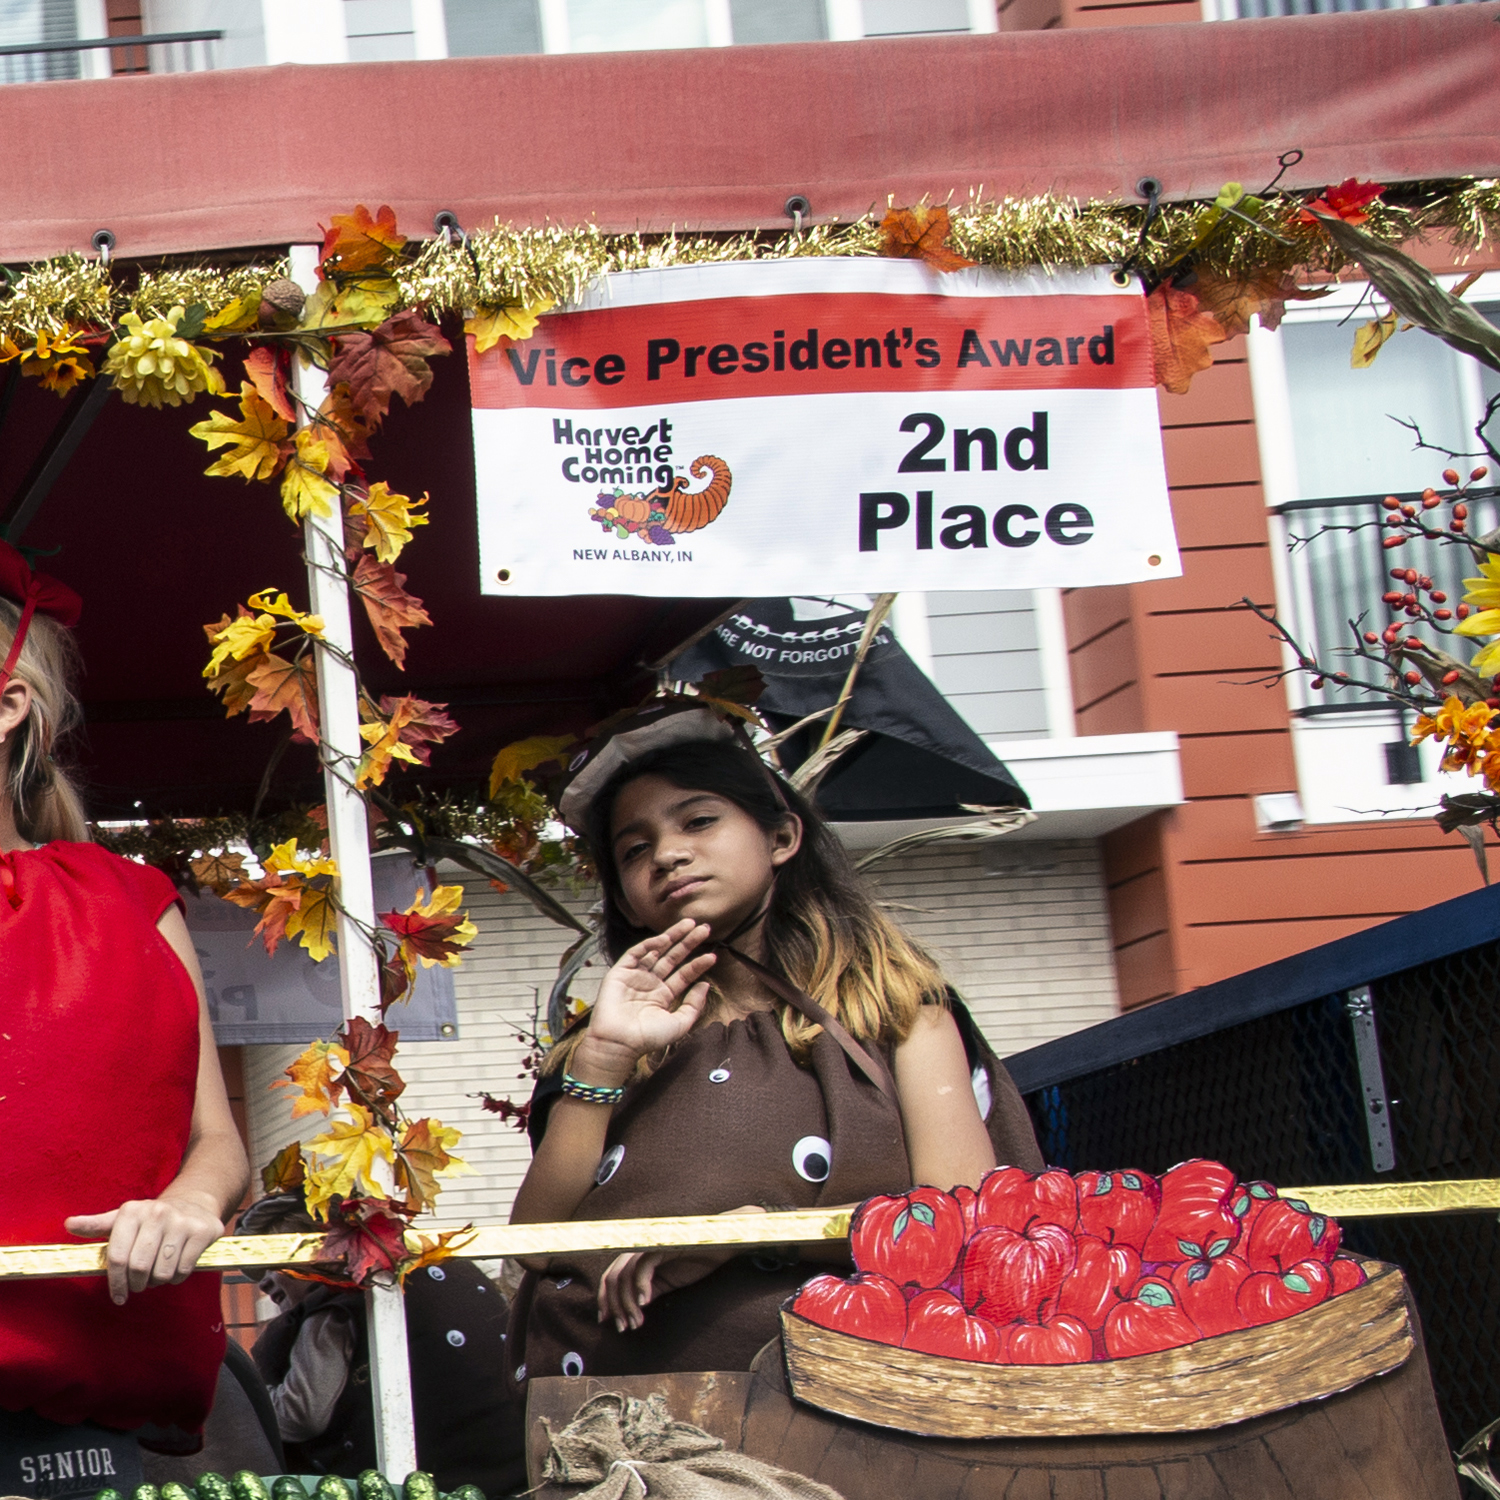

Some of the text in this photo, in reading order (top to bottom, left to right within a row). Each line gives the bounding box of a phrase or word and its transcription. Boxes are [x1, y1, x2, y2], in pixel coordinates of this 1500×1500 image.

[506, 347, 626, 387] Vice
[956, 325, 1115, 369] Award
[552, 417, 673, 446] Harvest
[897, 411, 1049, 474] 2nd
[585, 444, 673, 465] Home
[561, 456, 674, 493] Coming
[858, 490, 1095, 553] Place
[573, 549, 693, 563] NEW ALBANY, IN
[714, 624, 741, 648] ARE
[739, 640, 778, 660] NOT
[20, 1447, 117, 1484] SENIOR
